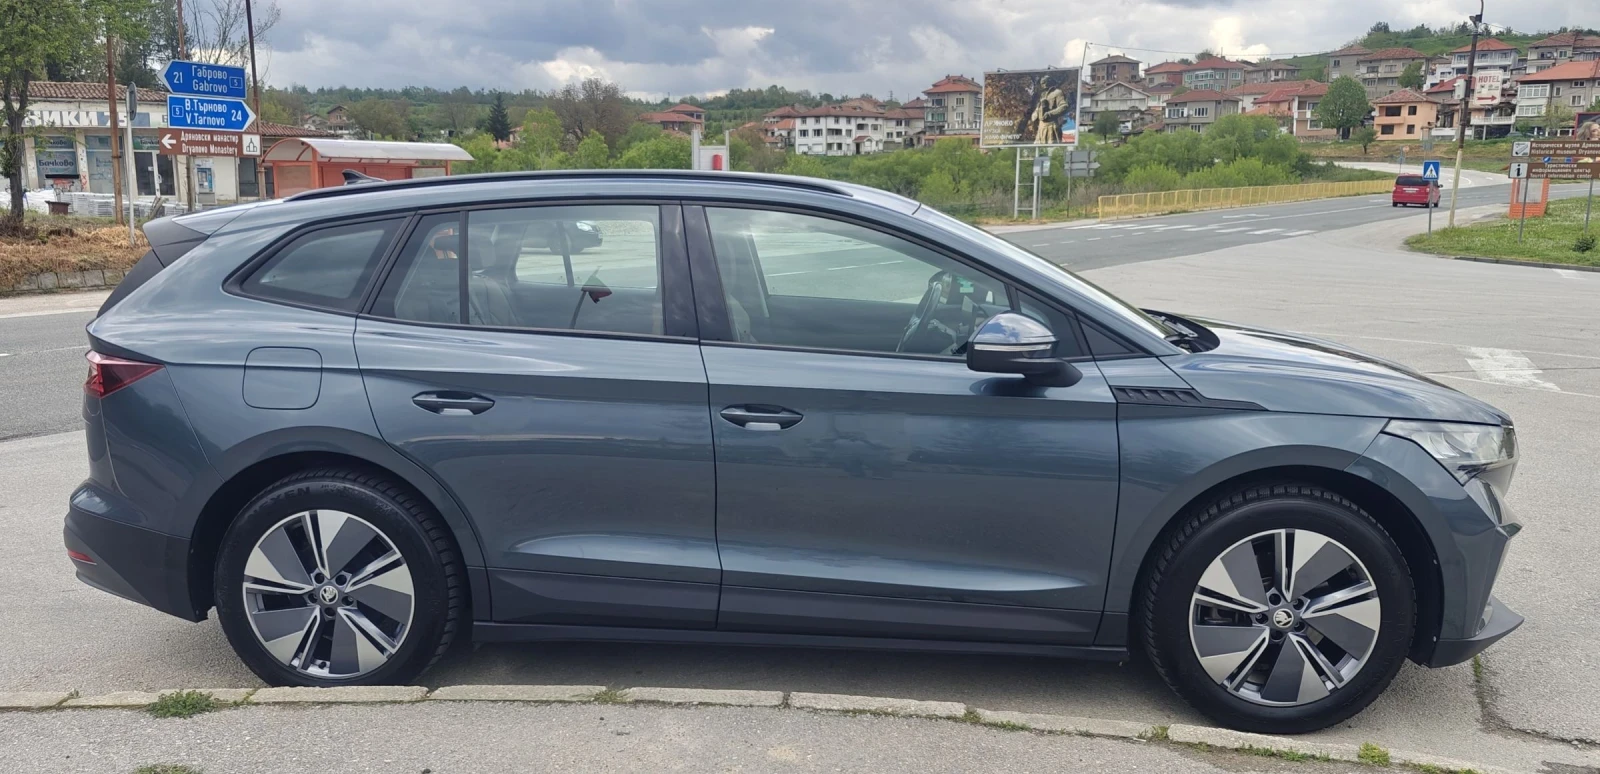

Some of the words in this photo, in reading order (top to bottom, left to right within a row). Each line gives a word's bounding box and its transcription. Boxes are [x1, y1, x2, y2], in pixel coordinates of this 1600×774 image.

[173, 71, 183, 84] 21
[191, 65, 227, 81] Габрово
[1478, 75, 1501, 83] HOTEL
[192, 79, 227, 93] Gabrovo
[233, 79, 238, 87] 5
[175, 107, 180, 116] 5
[184, 98, 227, 114] В.Търново
[185, 113, 226, 126] V.Tarnovo
[231, 110, 242, 122] 24
[181, 130, 211, 142] Дряновски
[213, 134, 239, 145] манастир
[182, 143, 208, 155] Dryanovo
[210, 143, 238, 157] Monastery
[38, 159, 74, 167] Бачково
